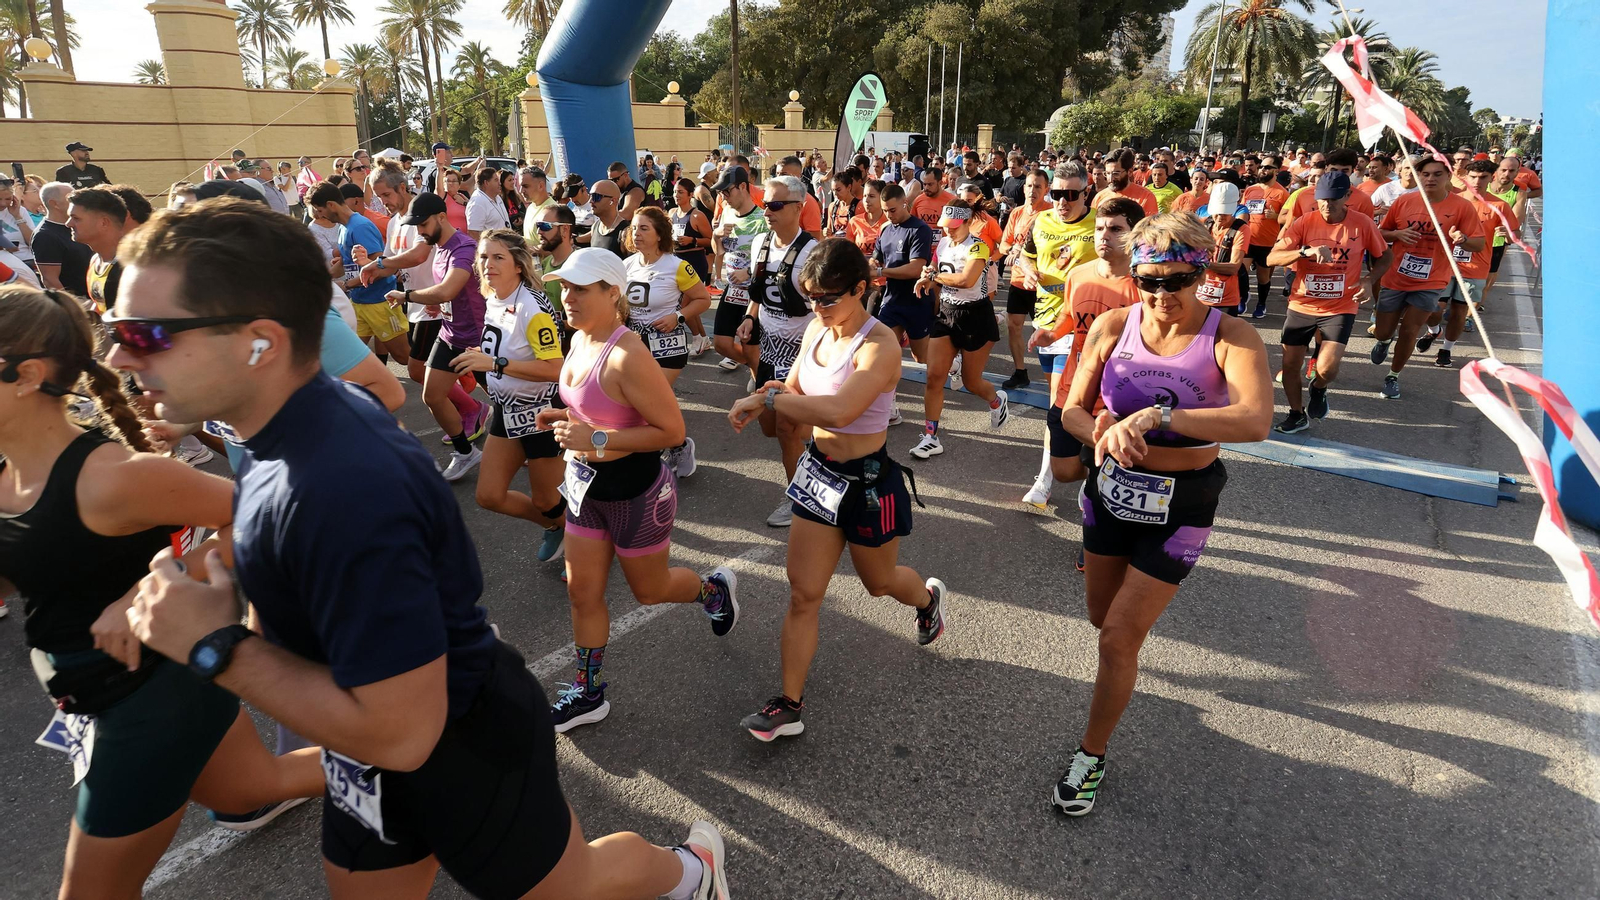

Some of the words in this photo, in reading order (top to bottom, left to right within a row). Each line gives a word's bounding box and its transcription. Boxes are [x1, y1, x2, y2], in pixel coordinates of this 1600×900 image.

[1406, 262, 1424, 272] 697
[1314, 282, 1334, 291] 333
[732, 289, 744, 298] 264
[660, 337, 679, 349] 823
[1115, 376, 1130, 391] No
[1179, 376, 1206, 402] vuela
[804, 474, 828, 502] 704
[1111, 484, 1147, 509] 621
